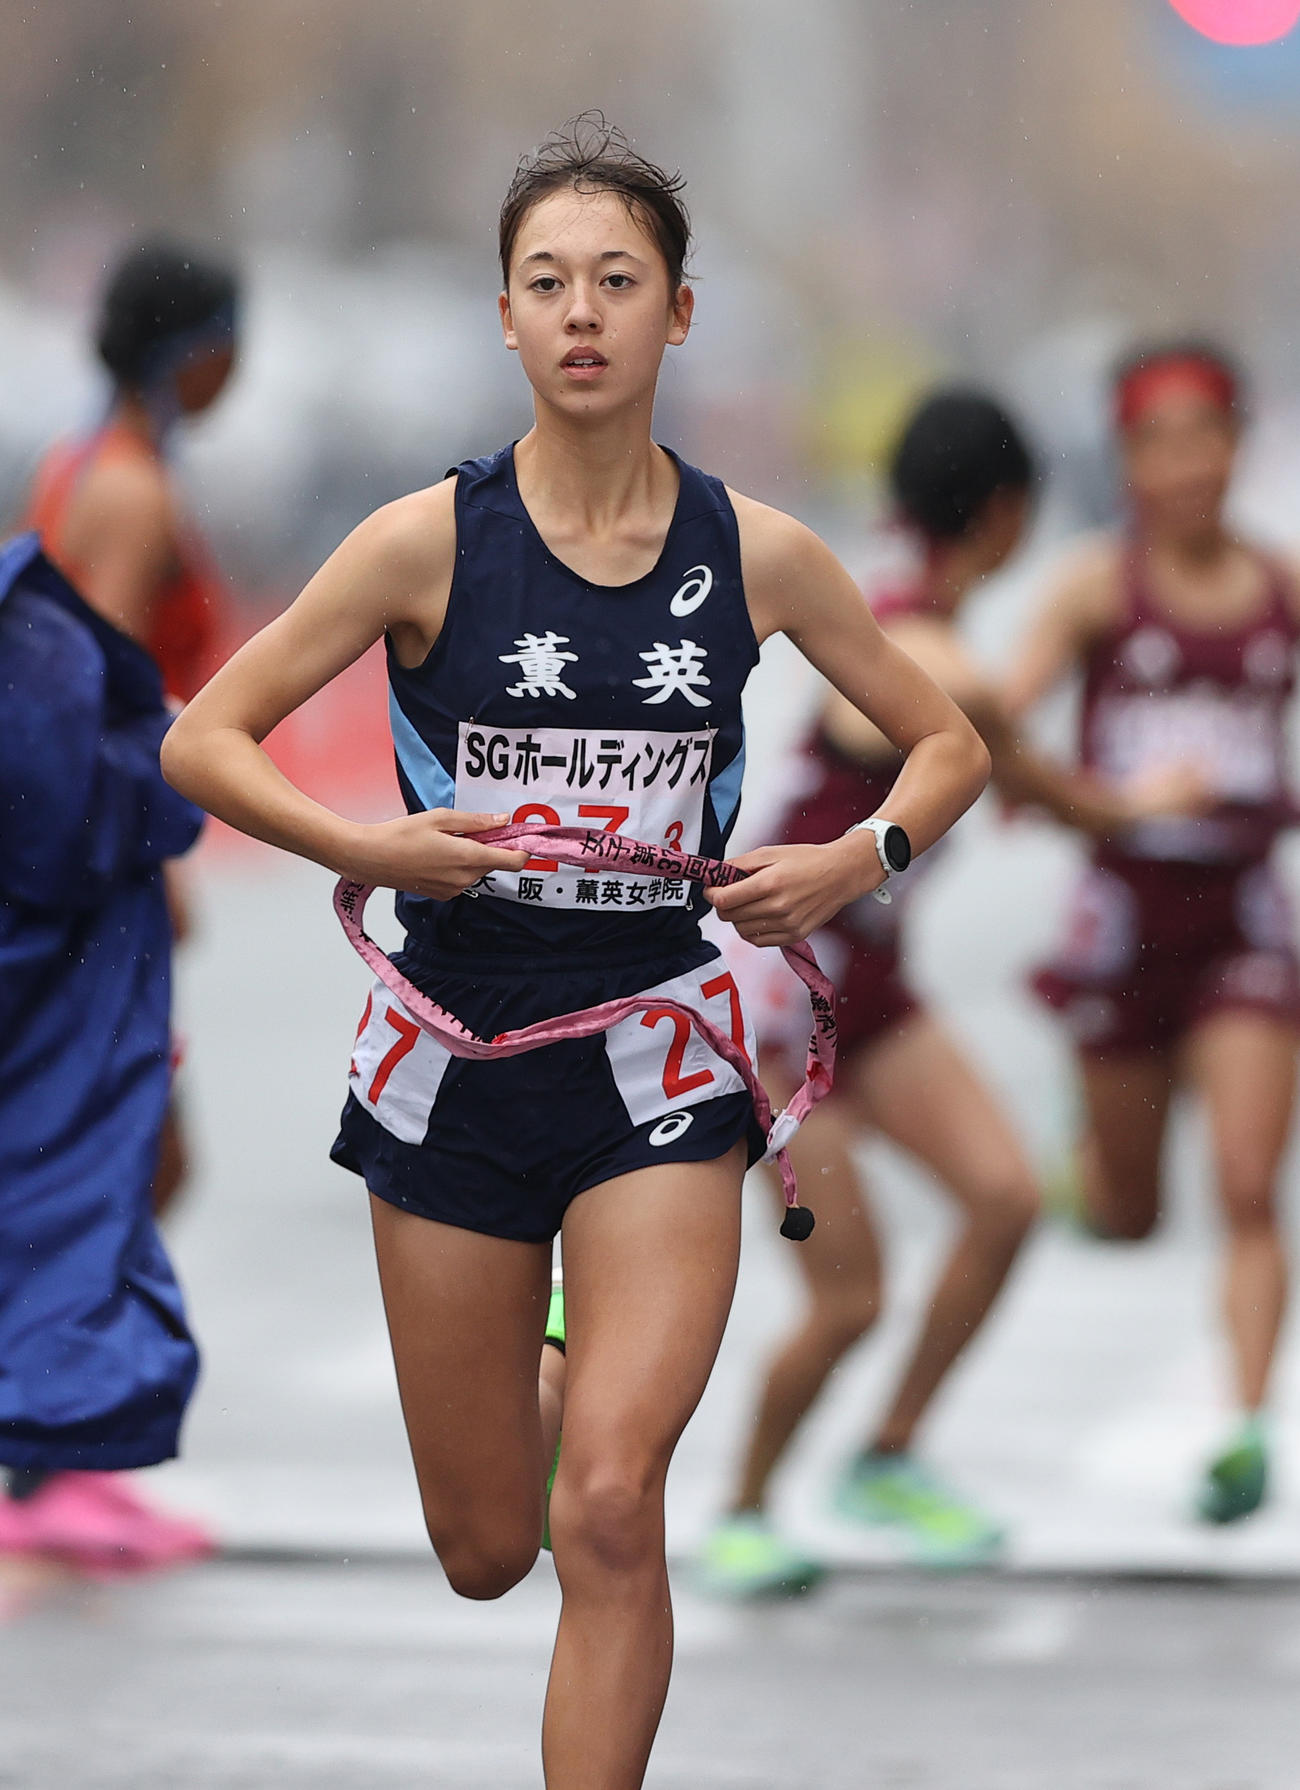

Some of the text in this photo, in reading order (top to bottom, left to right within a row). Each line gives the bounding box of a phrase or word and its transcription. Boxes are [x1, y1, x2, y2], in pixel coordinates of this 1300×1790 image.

[498, 631, 712, 707] 薫英
[465, 732, 713, 791] SGホールディングス
[353, 988, 422, 1107] 7
[640, 971, 752, 1100] 27
